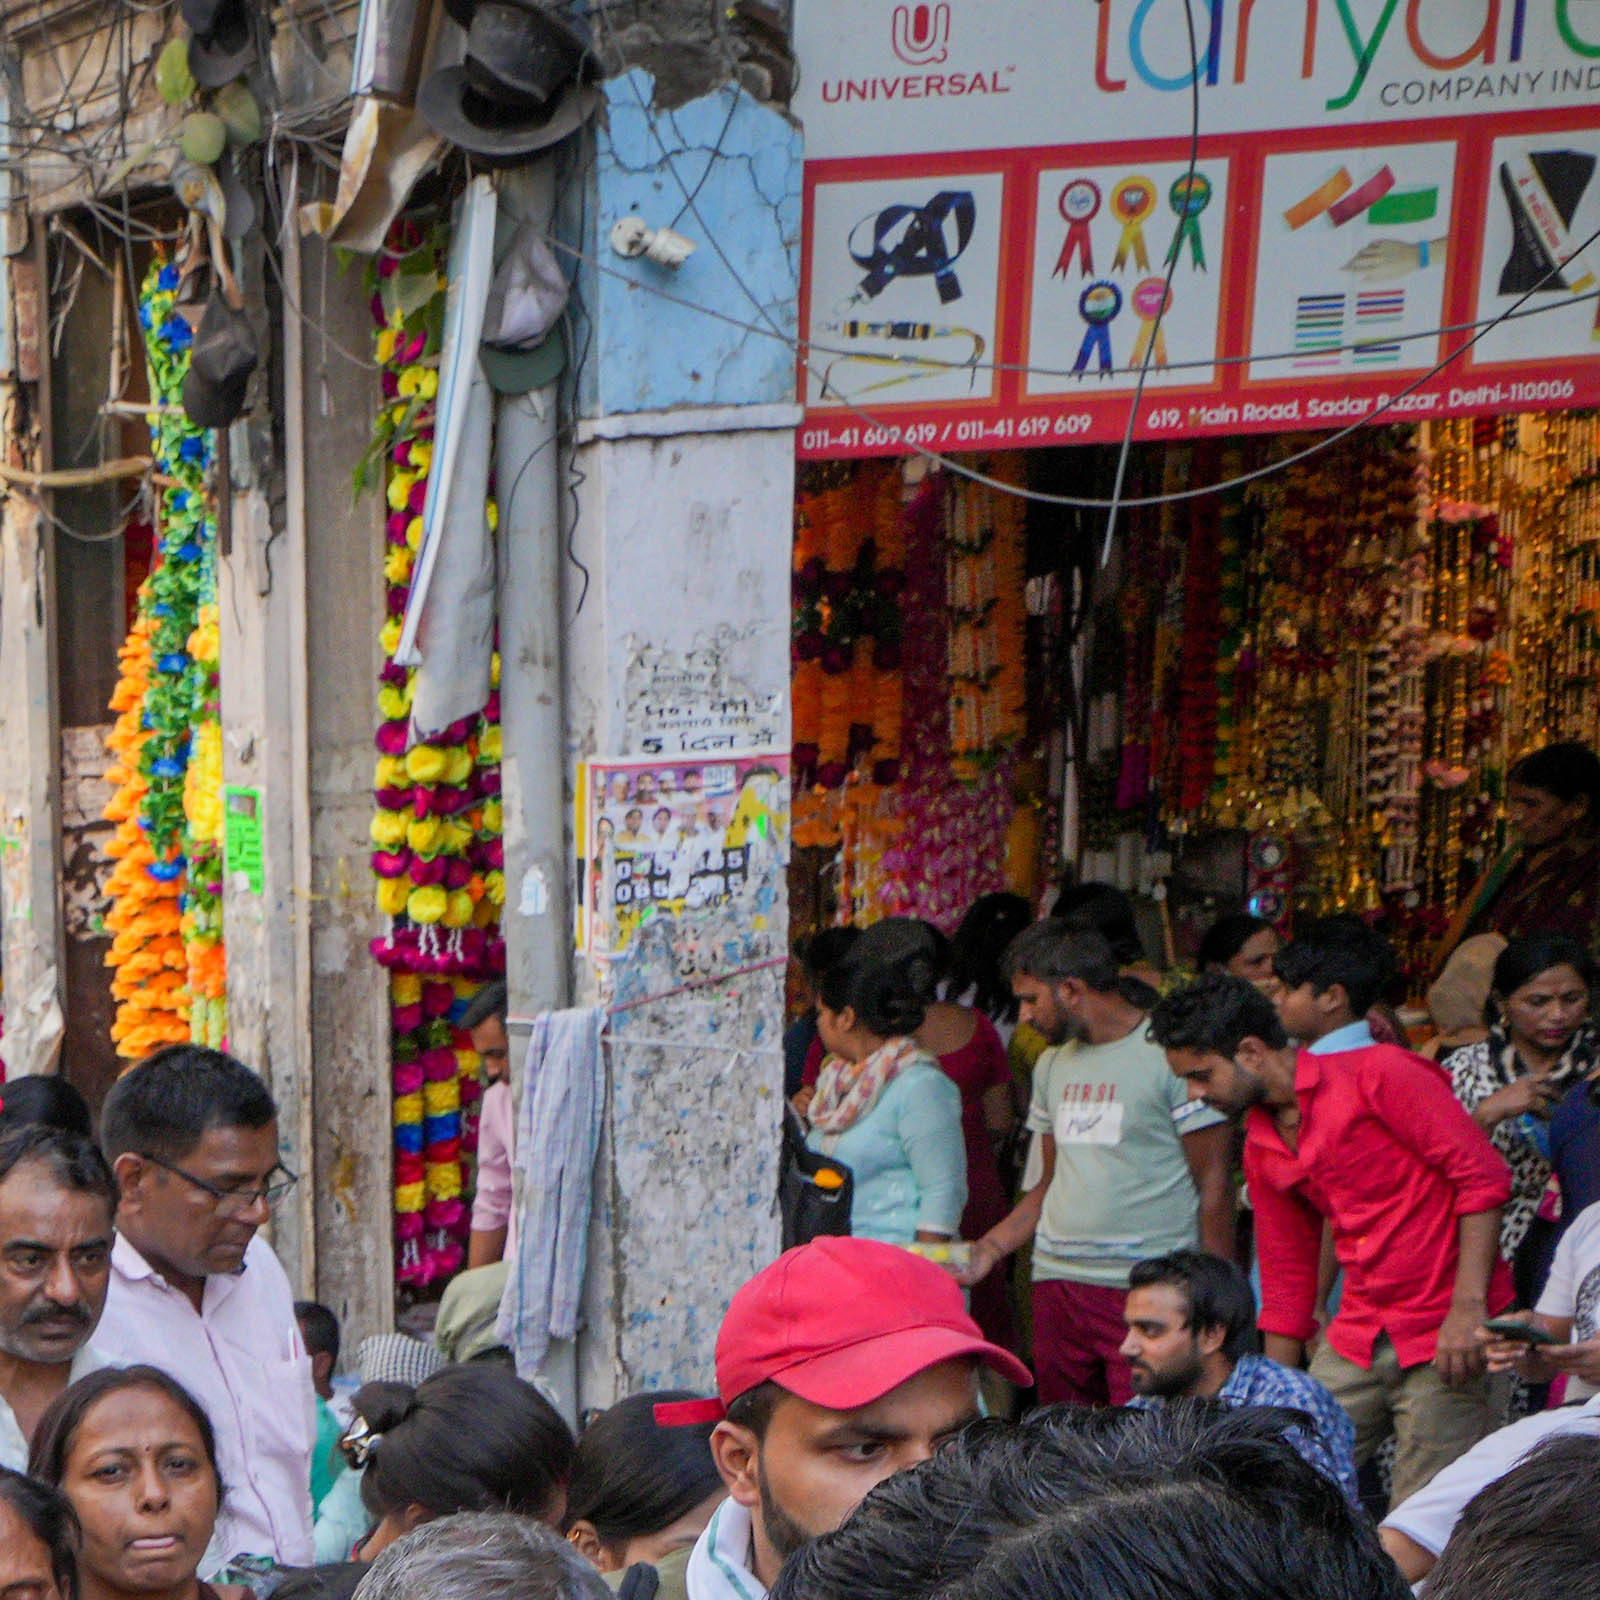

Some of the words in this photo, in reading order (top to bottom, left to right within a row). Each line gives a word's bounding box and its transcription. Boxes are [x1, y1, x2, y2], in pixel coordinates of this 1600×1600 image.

[1095, 0, 1600, 111] tanya
[1379, 69, 1545, 107] COMPANY
[1242, 402, 1301, 422] Road,
[1306, 397, 1369, 419] Sadar
[1448, 379, 1575, 407] Delhi-110006
[802, 428, 860, 450] 011-41
[862, 425, 900, 446] 609
[905, 422, 937, 443] 619
[956, 420, 1014, 441] 011-41
[1017, 416, 1050, 437] 619
[1053, 413, 1093, 434] 609
